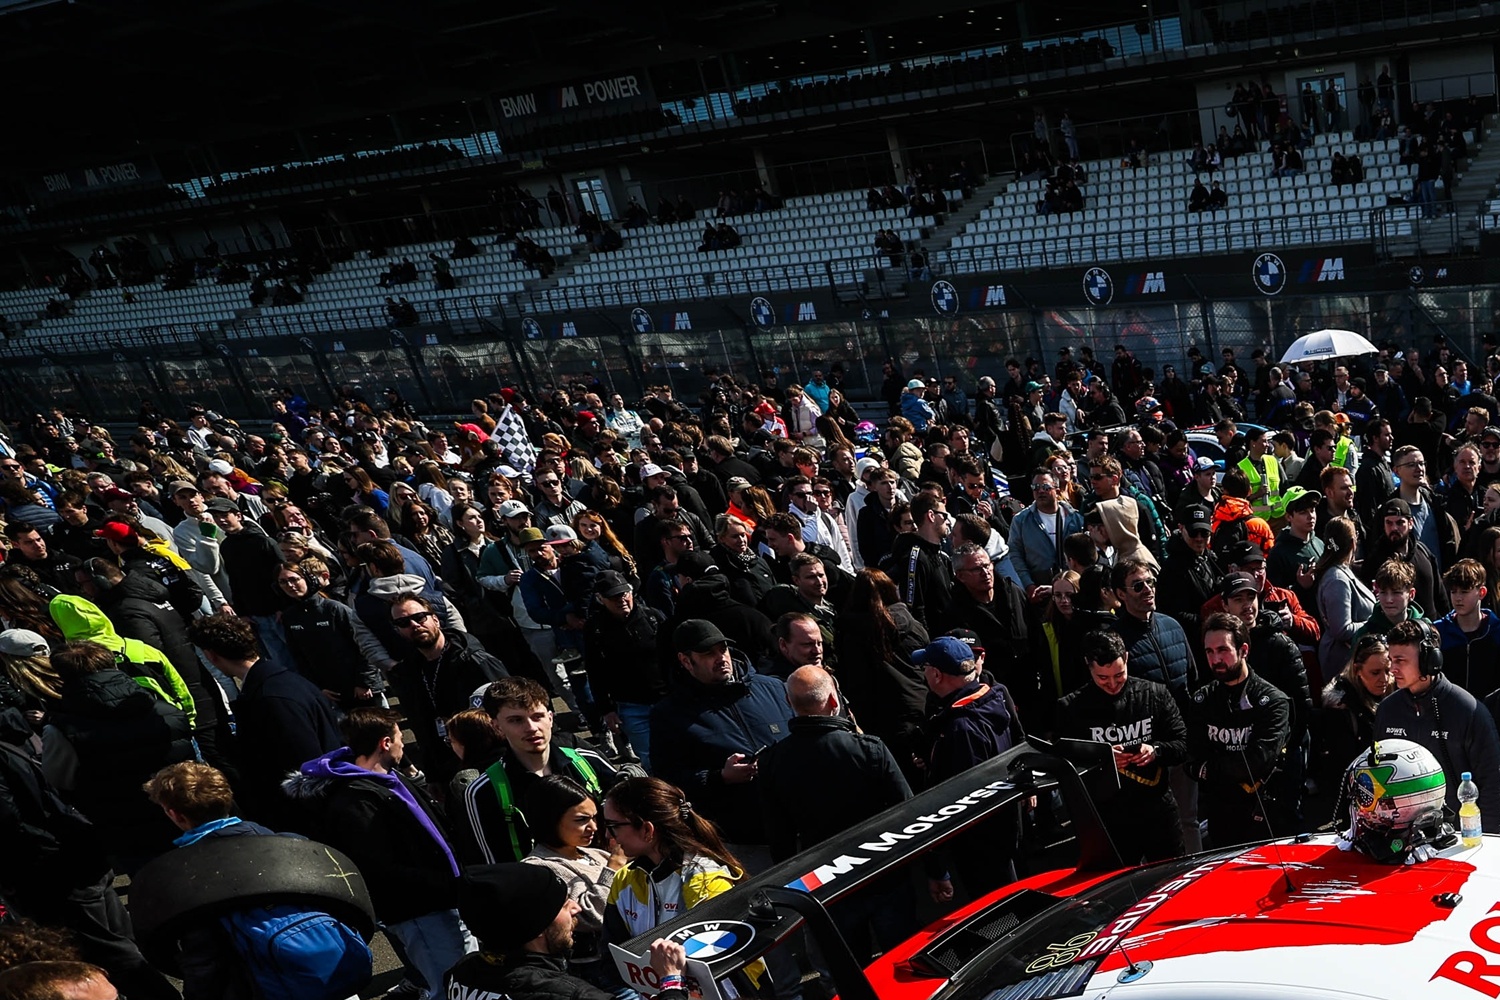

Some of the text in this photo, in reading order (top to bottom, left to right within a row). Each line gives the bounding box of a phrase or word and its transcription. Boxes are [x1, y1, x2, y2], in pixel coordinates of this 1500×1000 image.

[500, 75, 641, 118] BMW M POWER
[43, 173, 72, 193] BMW
[99, 162, 141, 184] POWER
[1317, 257, 1345, 282] M
[1142, 271, 1167, 295] M
[984, 285, 1007, 307] M
[674, 312, 692, 331] M
[797, 301, 817, 321] M
[1089, 718, 1152, 742] ROWE
[1207, 723, 1250, 745] ROWE
[814, 854, 872, 886] M
[1080, 859, 1226, 958] WEMPE
[1025, 931, 1099, 974] 98
